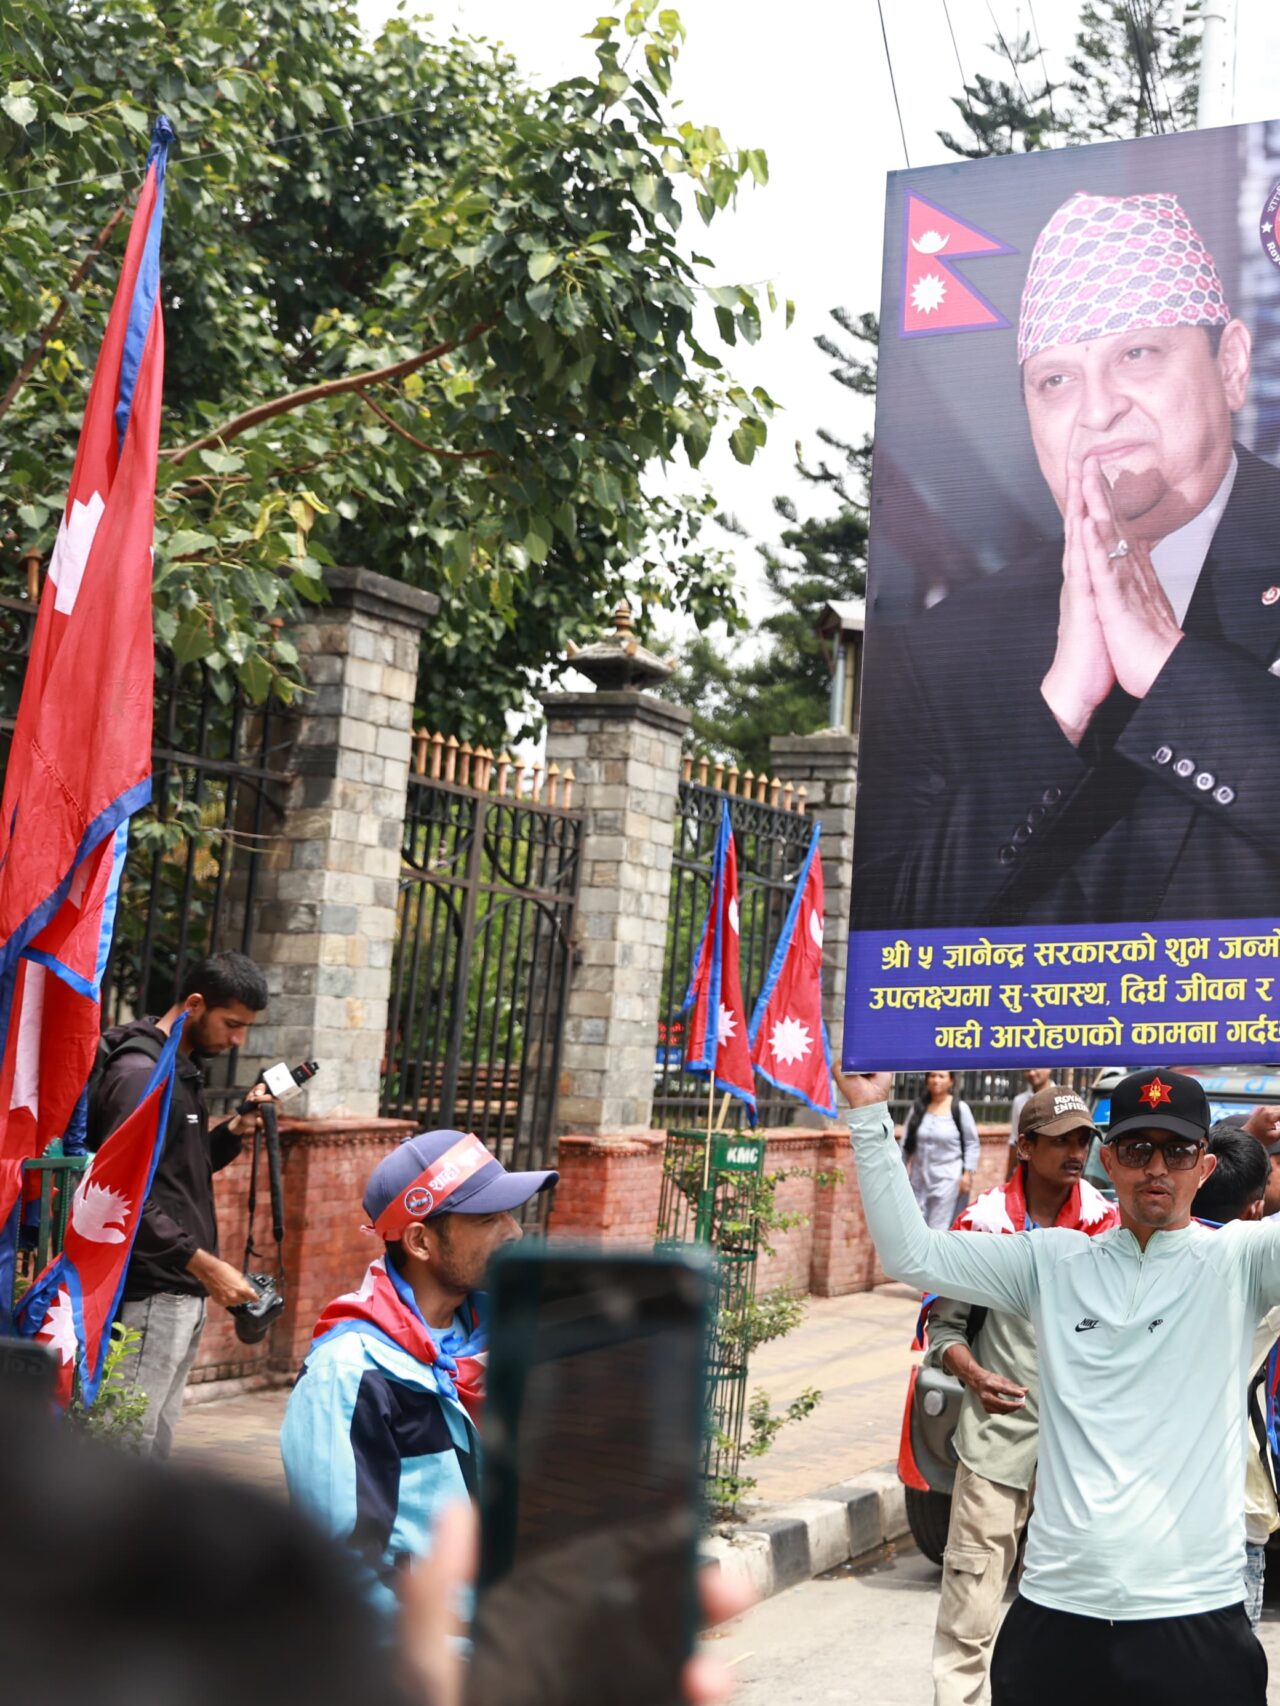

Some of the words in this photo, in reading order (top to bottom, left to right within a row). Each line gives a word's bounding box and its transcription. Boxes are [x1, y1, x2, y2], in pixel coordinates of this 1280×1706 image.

[881, 940, 912, 970] श्री
[918, 946, 934, 970] ५
[942, 937, 1027, 969] ज्ञानेन्द्र
[1033, 932, 1158, 967] सरकारको
[1164, 937, 1211, 967] शुभ
[868, 984, 993, 1011] उपलक्ष्यमा
[1120, 972, 1168, 1005] दिर्घ
[1174, 971, 1248, 1002] जीवन
[1254, 978, 1275, 1002] र
[989, 1016, 1125, 1050] आरोहणको
[1130, 1021, 1219, 1045] कामना
[726, 1147, 759, 1164] KMC
[1080, 1317, 1100, 1328] NIKE
